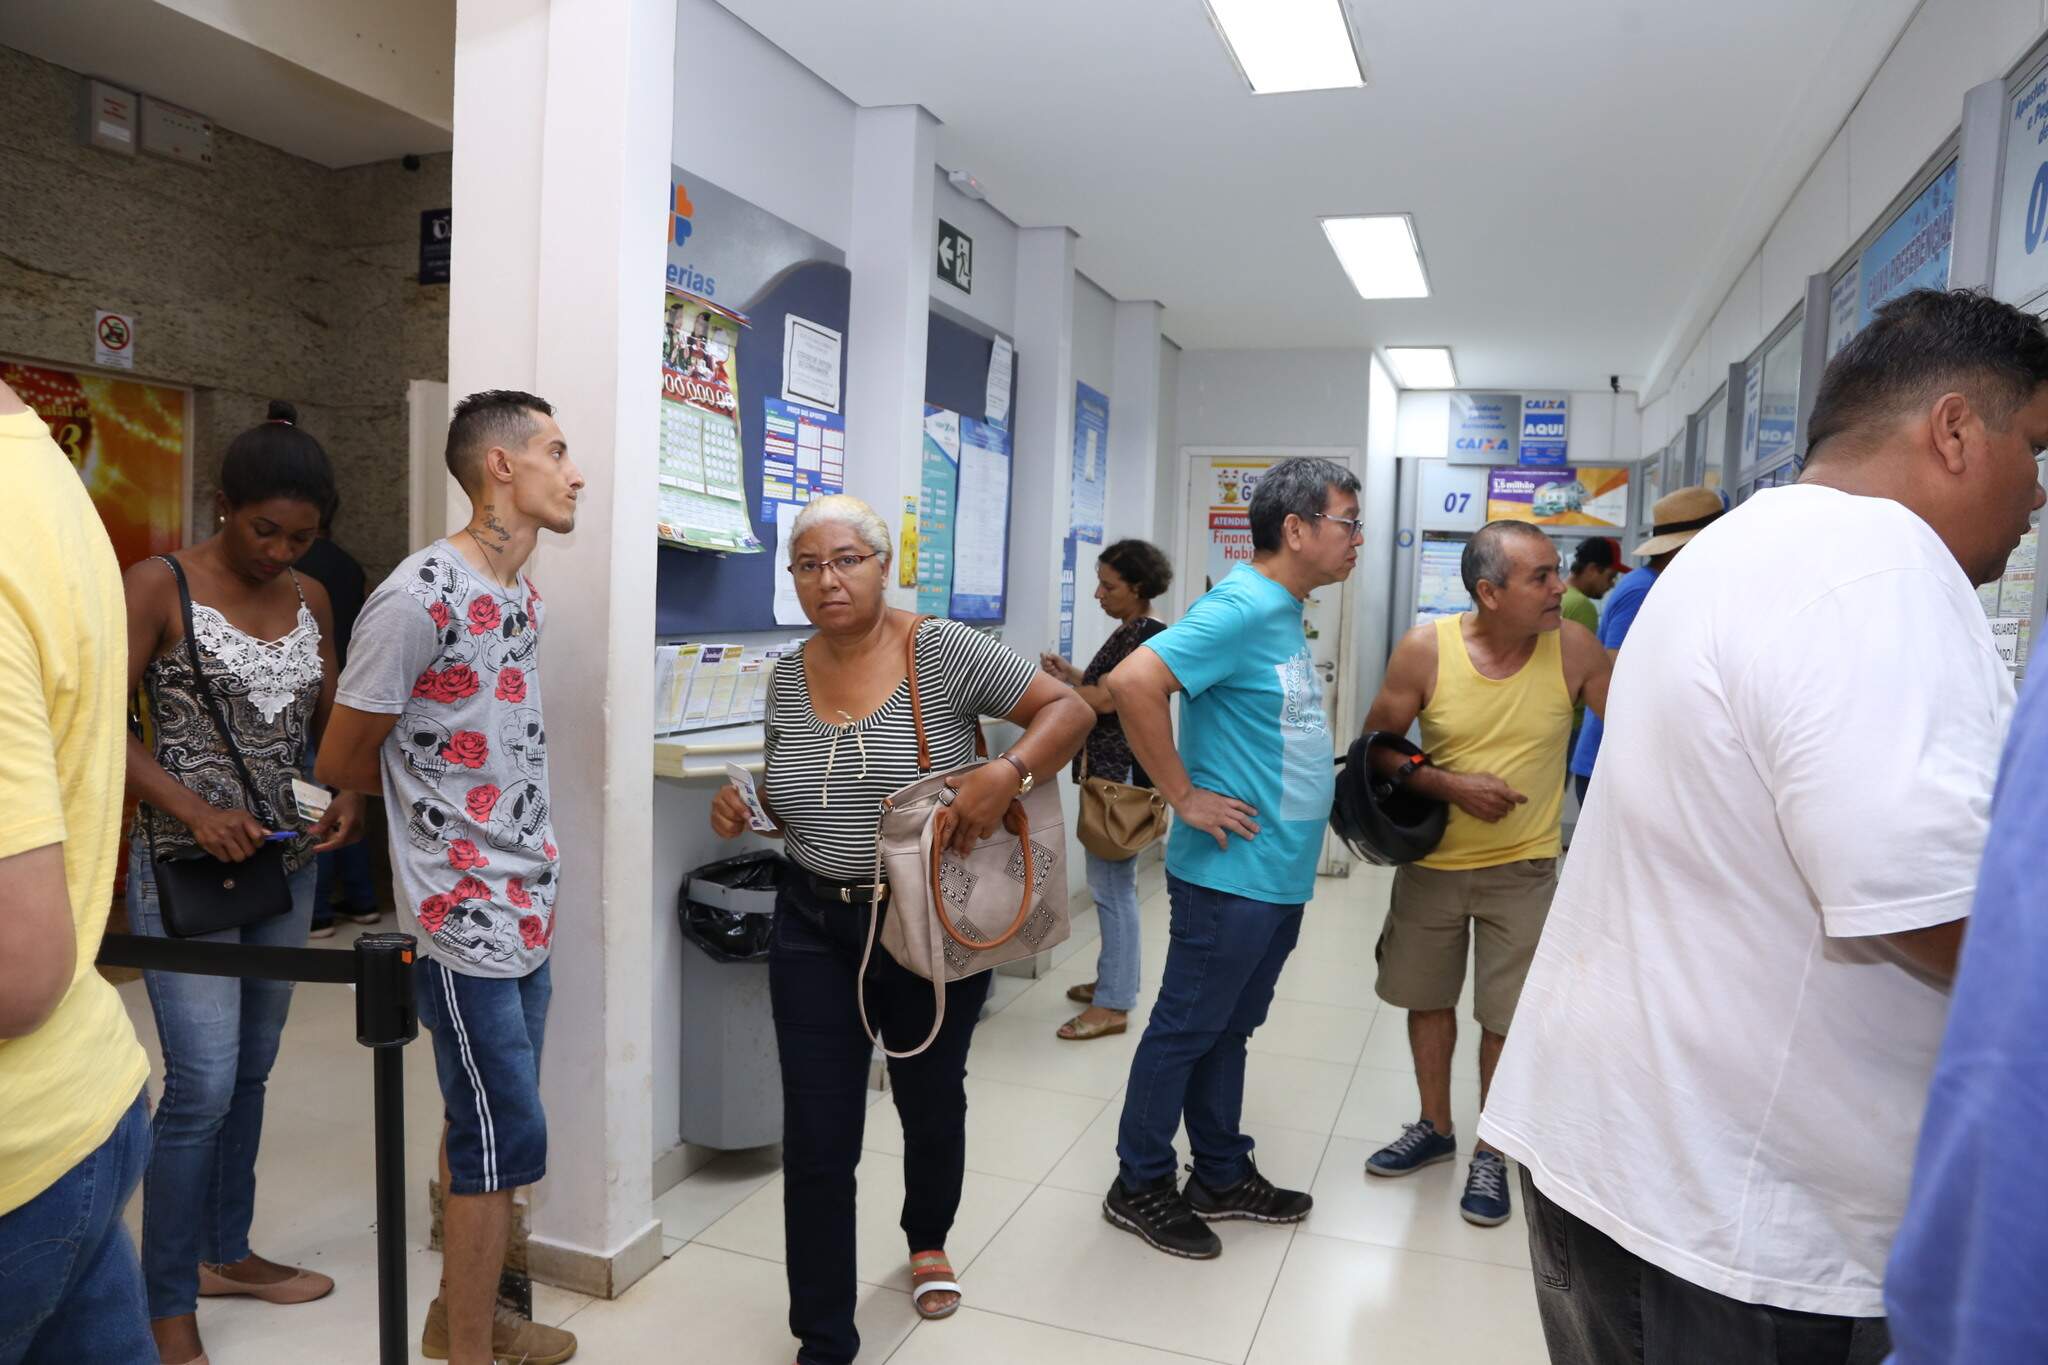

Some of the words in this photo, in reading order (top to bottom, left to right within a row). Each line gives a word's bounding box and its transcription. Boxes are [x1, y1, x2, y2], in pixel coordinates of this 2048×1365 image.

[2025, 161, 2048, 255] 0
[1525, 400, 1566, 410] CAIXA
[1524, 423, 1564, 435] AQUI
[1456, 437, 1509, 453] CAIXA
[1444, 493, 1471, 513] 07
[1992, 621, 2018, 635] AGUARDE
